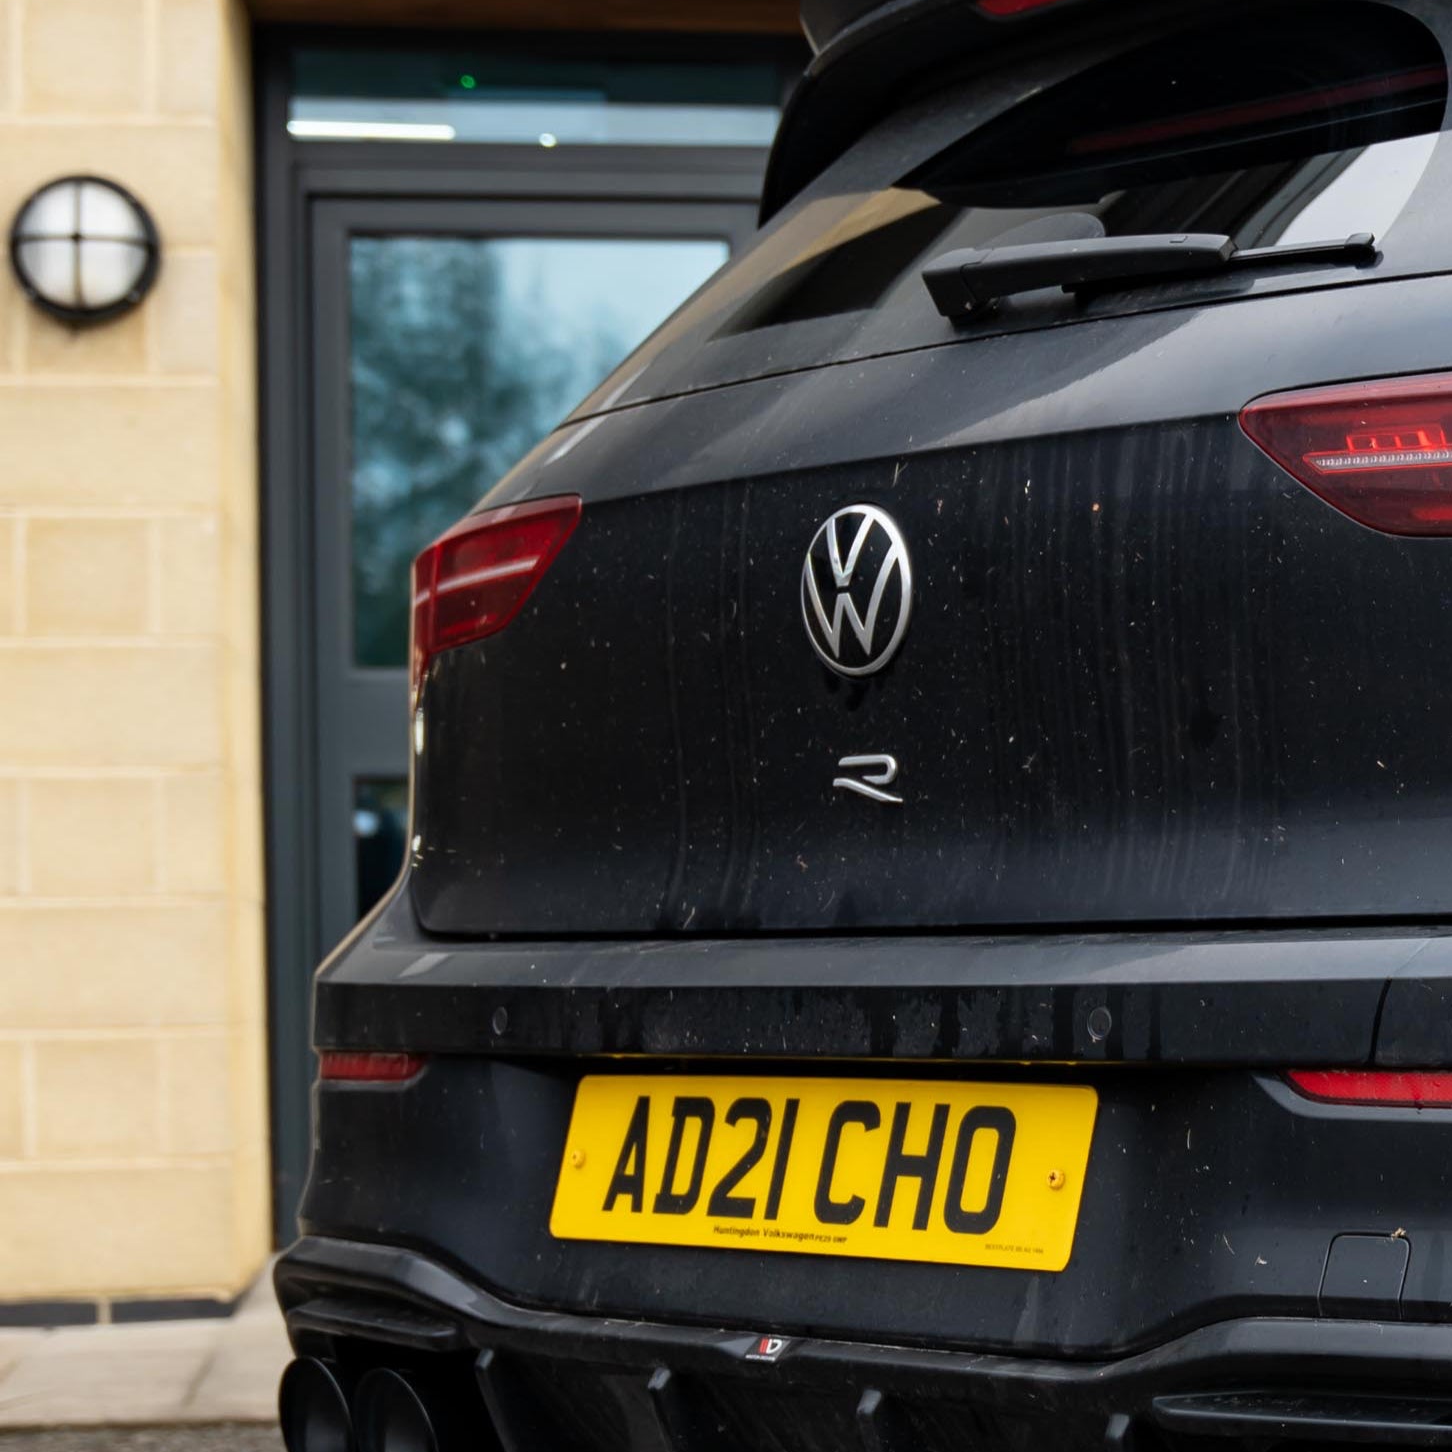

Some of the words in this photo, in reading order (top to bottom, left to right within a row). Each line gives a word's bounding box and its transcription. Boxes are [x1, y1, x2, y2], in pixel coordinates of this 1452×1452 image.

[832, 753, 904, 803] R
[602, 1095, 800, 1221] AD21
[813, 1100, 1017, 1235] CHO
[713, 1226, 760, 1238] Huntingdon
[763, 1228, 814, 1242] Volkswagen
